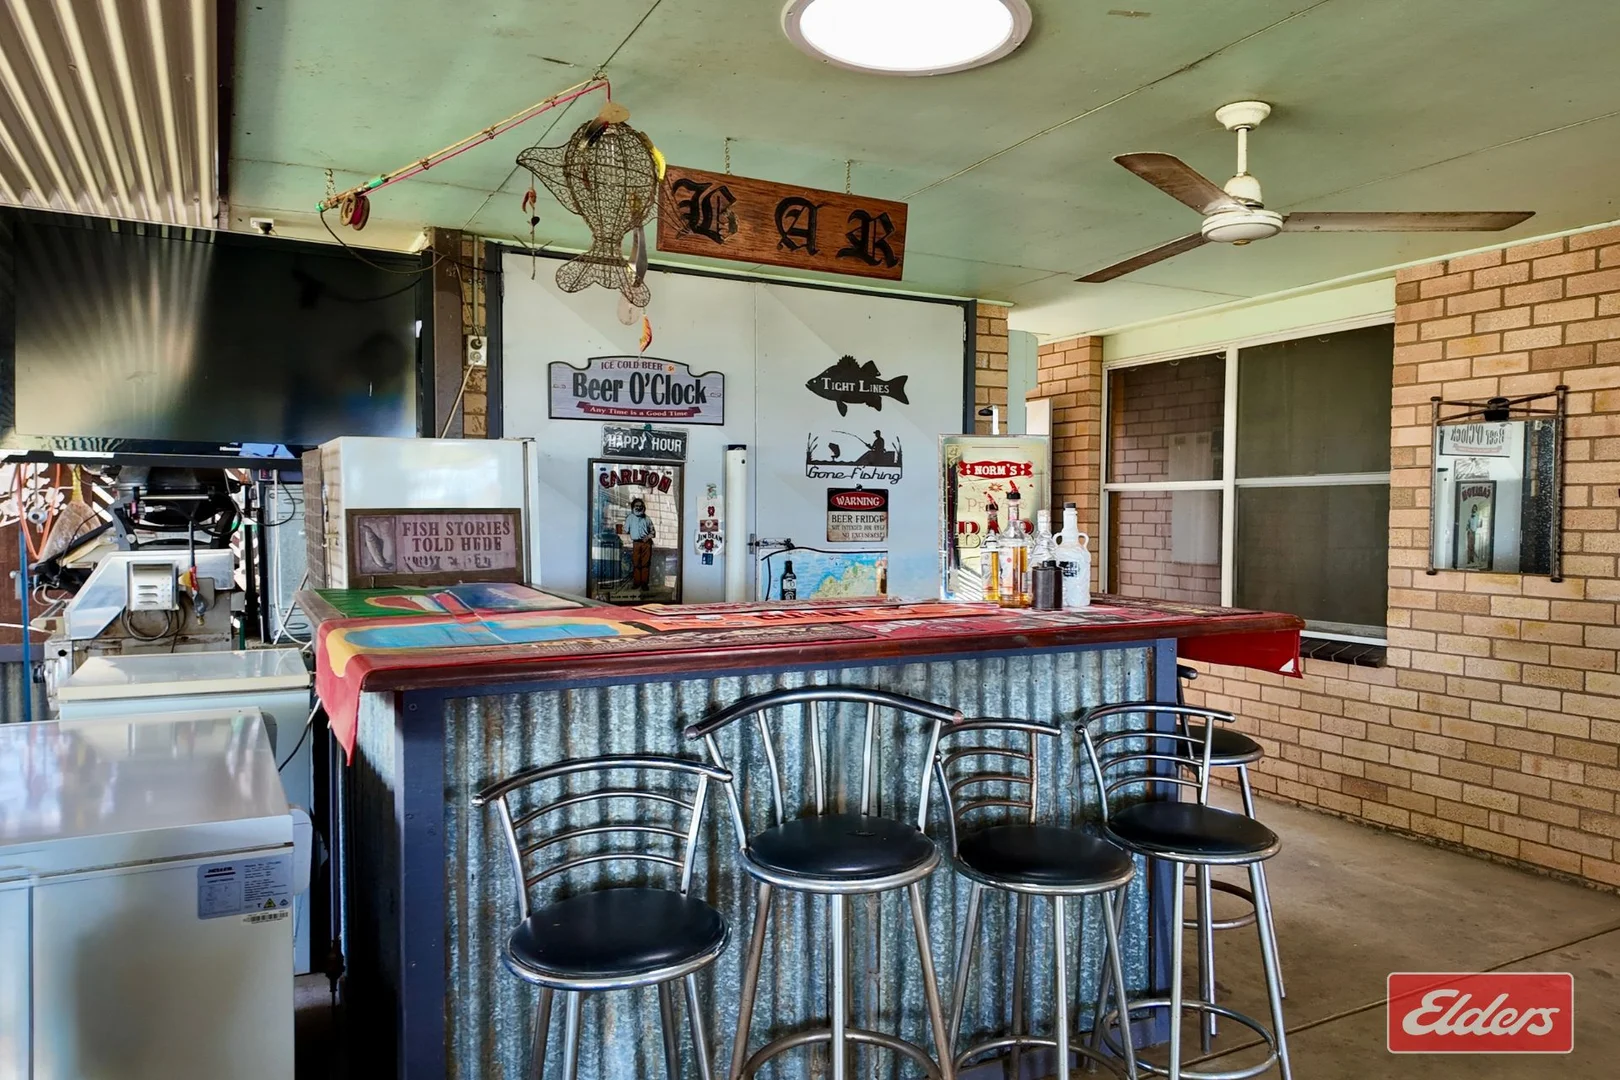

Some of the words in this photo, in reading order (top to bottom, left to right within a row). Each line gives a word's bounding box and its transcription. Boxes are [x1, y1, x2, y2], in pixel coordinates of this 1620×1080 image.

[672, 178, 900, 268] BAR
[601, 361, 614, 370] ICE
[617, 360, 639, 369] COLD
[641, 361, 663, 371] BEER
[572, 372, 624, 403] Beer
[629, 371, 707, 405] O'Clock
[821, 377, 856, 392] TIGHT
[859, 380, 890, 394] LINES
[590, 406, 606, 414] Any
[646, 409, 667, 417] Good
[607, 431, 647, 451] HAPPY
[651, 437, 682, 452] HOUR
[808, 465, 847, 479] Gone
[850, 465, 902, 485] Fishing
[974, 464, 1018, 476] NORM'S
[835, 495, 880, 506] WARNING
[831, 515, 853, 523] BEER
[855, 515, 885, 523] FRIDGE
[402, 521, 439, 536] FISH
[446, 521, 511, 536] STORIES
[412, 537, 454, 552] TOLD
